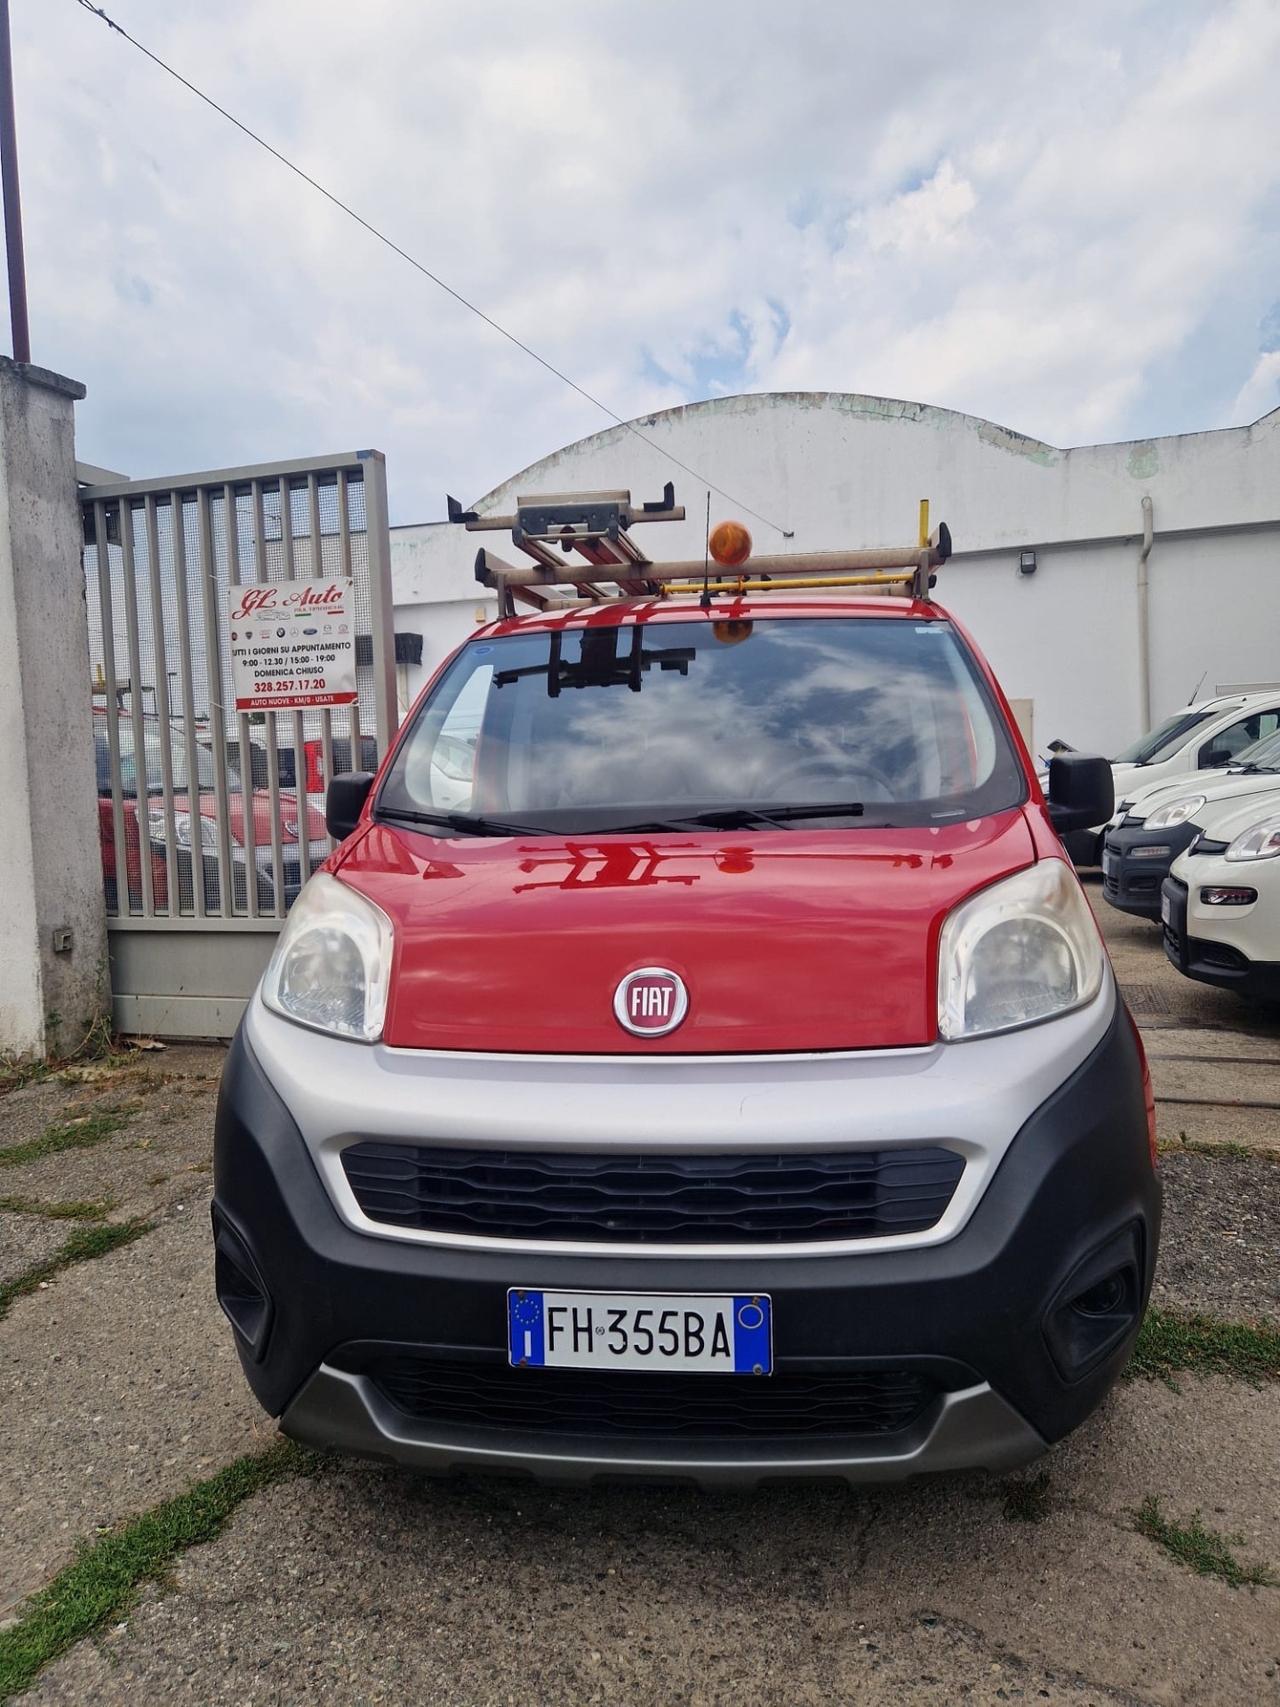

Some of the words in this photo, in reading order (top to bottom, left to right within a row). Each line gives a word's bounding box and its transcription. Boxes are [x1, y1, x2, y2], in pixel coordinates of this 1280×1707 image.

[283, 585, 342, 606] Auto
[252, 648, 279, 656] GIORNI
[291, 642, 351, 653] APPUNTAMENTO
[290, 656, 310, 664] 15:00
[316, 654, 335, 663] 19:00
[254, 668, 294, 677] DOMENICA
[296, 666, 324, 675] CHIUSO
[254, 678, 326, 693] 328.257.17.20
[268, 697, 289, 705] NUOVE
[315, 695, 334, 703] USATE
[632, 987, 673, 1016] FIAT
